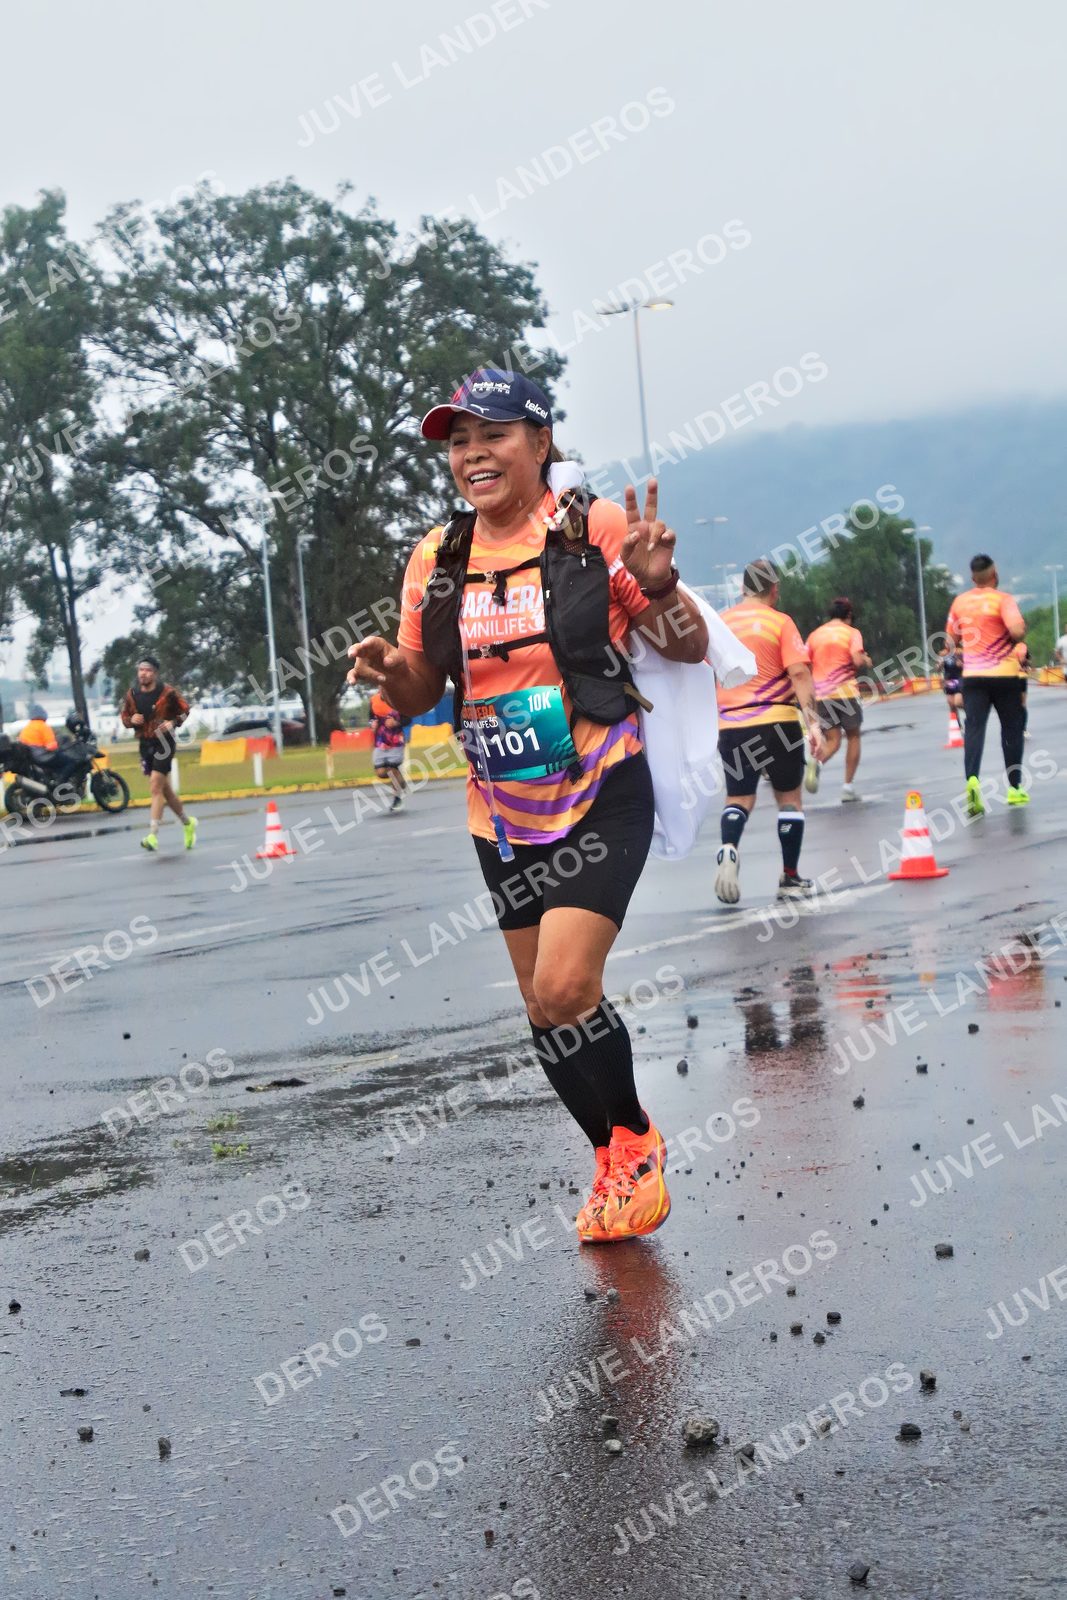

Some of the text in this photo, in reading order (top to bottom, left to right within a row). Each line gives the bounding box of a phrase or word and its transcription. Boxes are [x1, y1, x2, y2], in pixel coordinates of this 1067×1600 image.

[525, 399, 549, 419] telcel
[463, 617, 527, 639] MNILIFE
[528, 690, 552, 712] 10K
[480, 727, 541, 758] 1101
